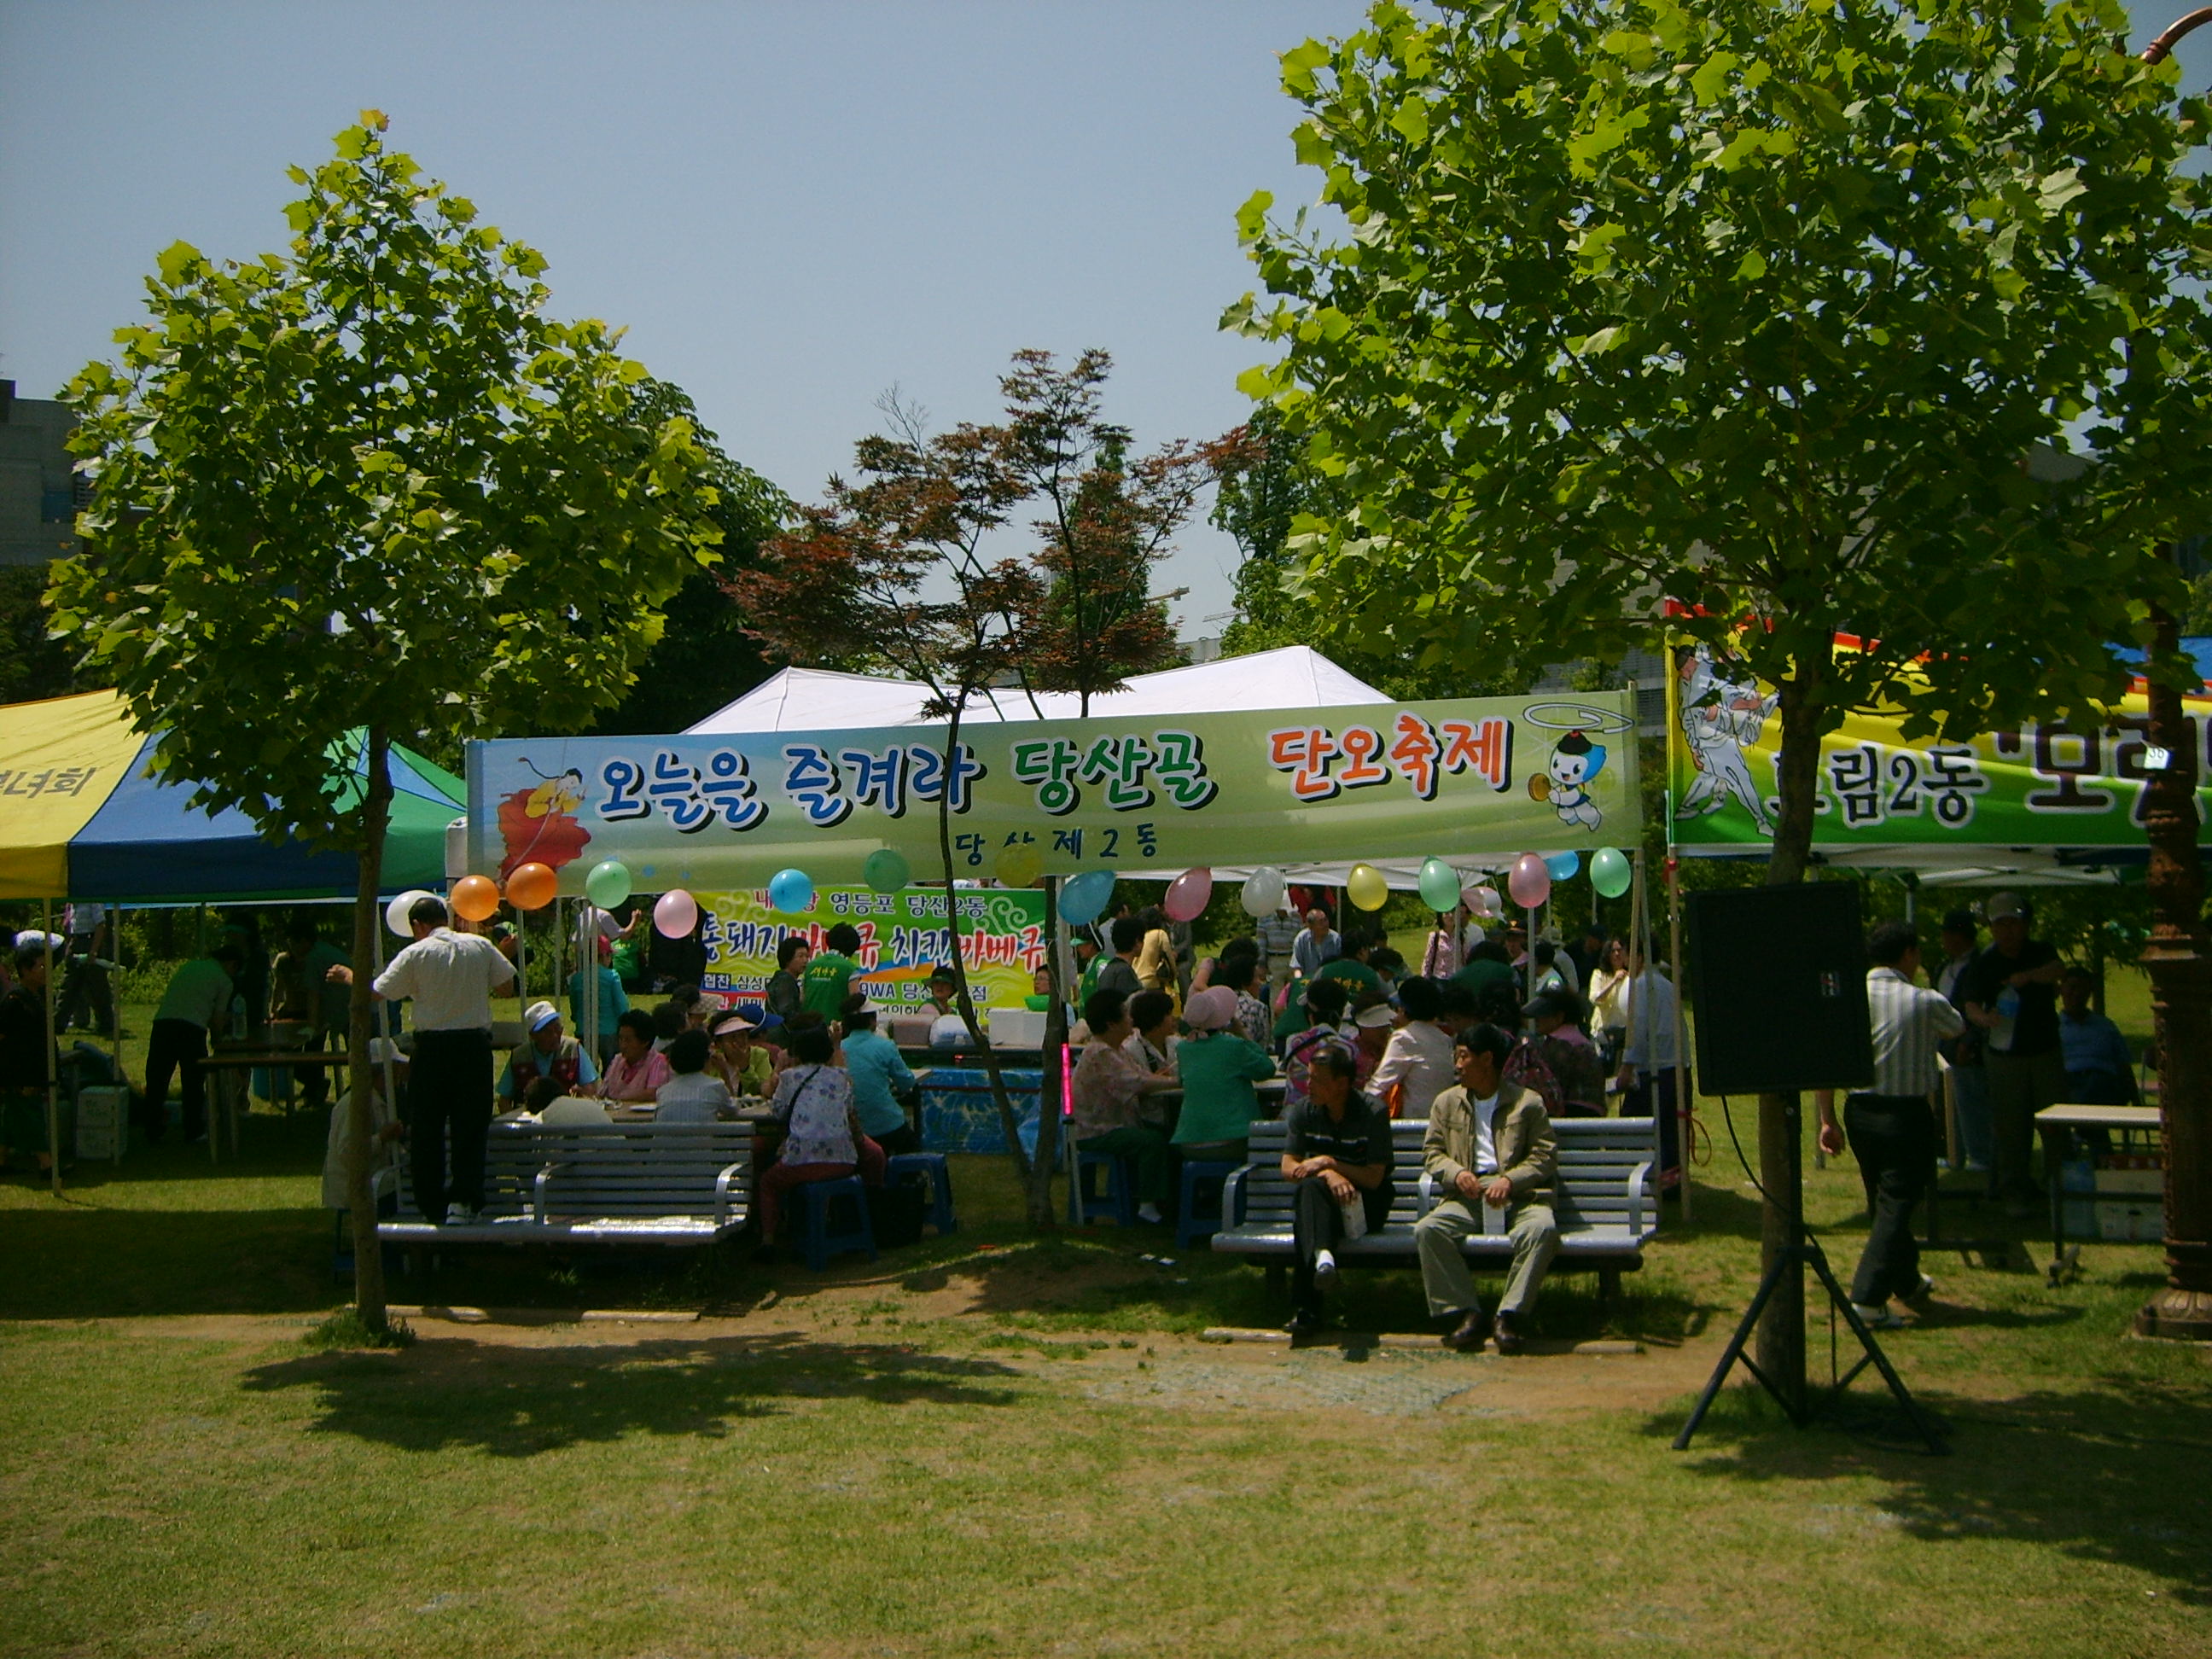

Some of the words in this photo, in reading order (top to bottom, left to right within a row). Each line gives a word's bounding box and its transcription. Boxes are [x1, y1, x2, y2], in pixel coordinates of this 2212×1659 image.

[597, 749, 765, 831] 오늘을
[1012, 728, 1217, 814] 당산골
[1268, 710, 1513, 799] 단오축제
[1767, 742, 1988, 826] 림2동
[830, 892, 895, 914] 영등포
[906, 894, 987, 918] 당산2동
